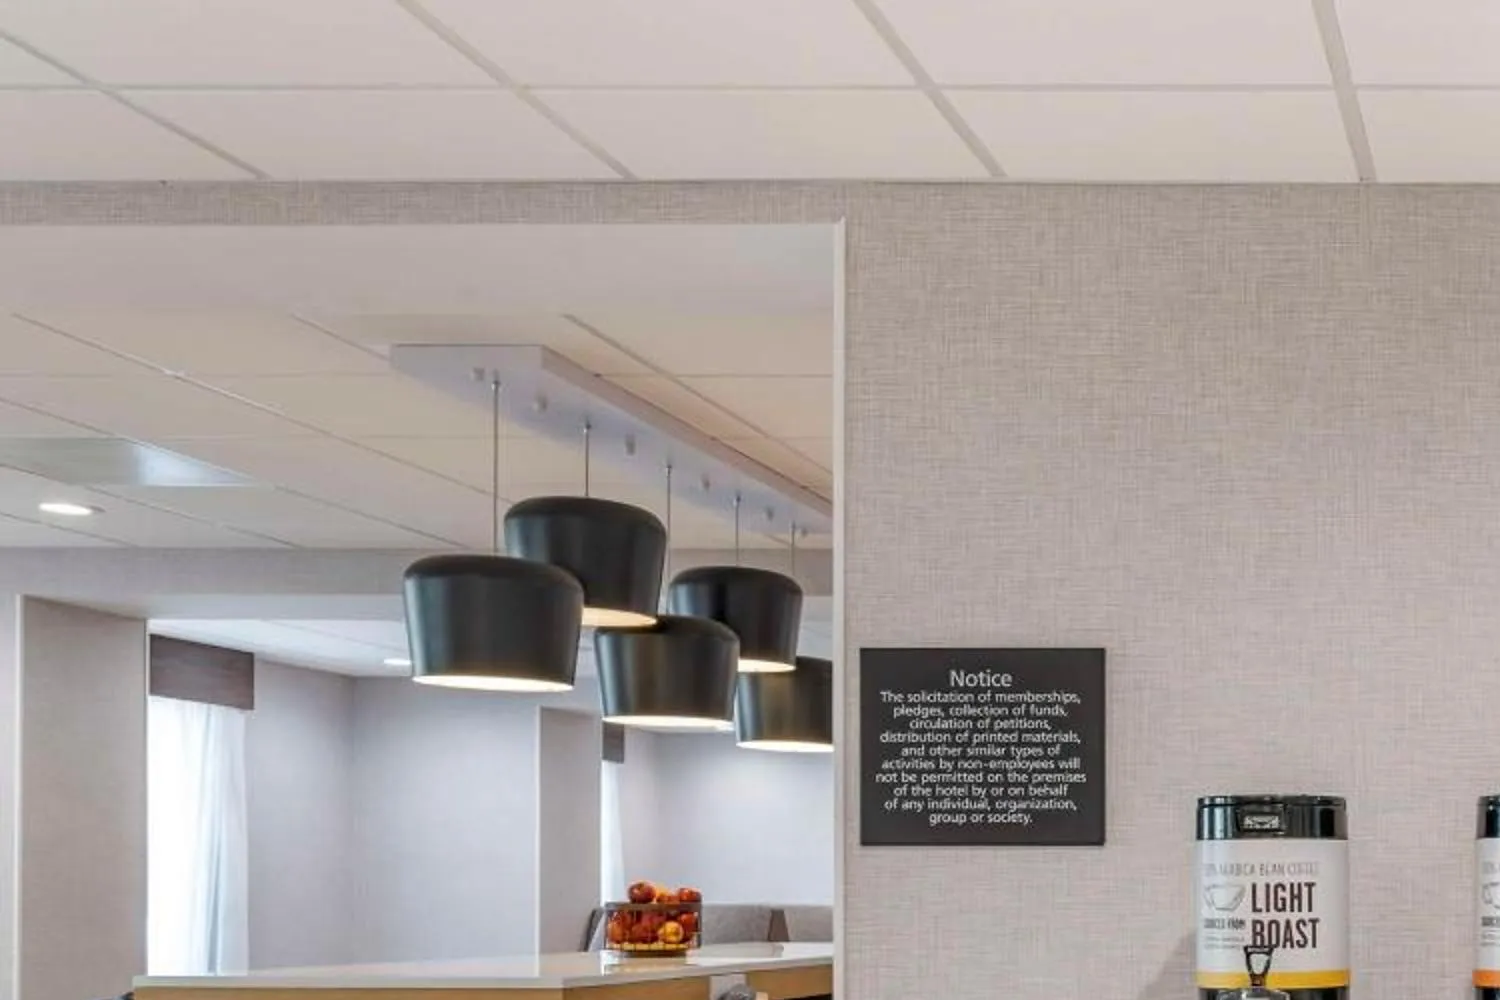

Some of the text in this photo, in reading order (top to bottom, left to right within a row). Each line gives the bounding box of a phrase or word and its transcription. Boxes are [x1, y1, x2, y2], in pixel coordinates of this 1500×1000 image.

[950, 669, 1012, 687] Notice
[879, 691, 1081, 705] The solicitation of memberships,
[893, 704, 1067, 719] pledges, collection of funds,
[909, 717, 1052, 732] circulation of petitions,
[879, 731, 1081, 745] distribution of printed materials,
[901, 744, 1061, 759] and other similar types of
[881, 758, 1081, 772] activities by non-employees will
[875, 771, 1087, 785] not be permitted on the premises
[893, 784, 1068, 799] of the hotel by or on behalf
[884, 797, 1077, 812] of any individual, organization,
[929, 810, 1033, 826] group or society.
[1251, 882, 1317, 913] LIGHT
[1251, 917, 1321, 949] ROAST
